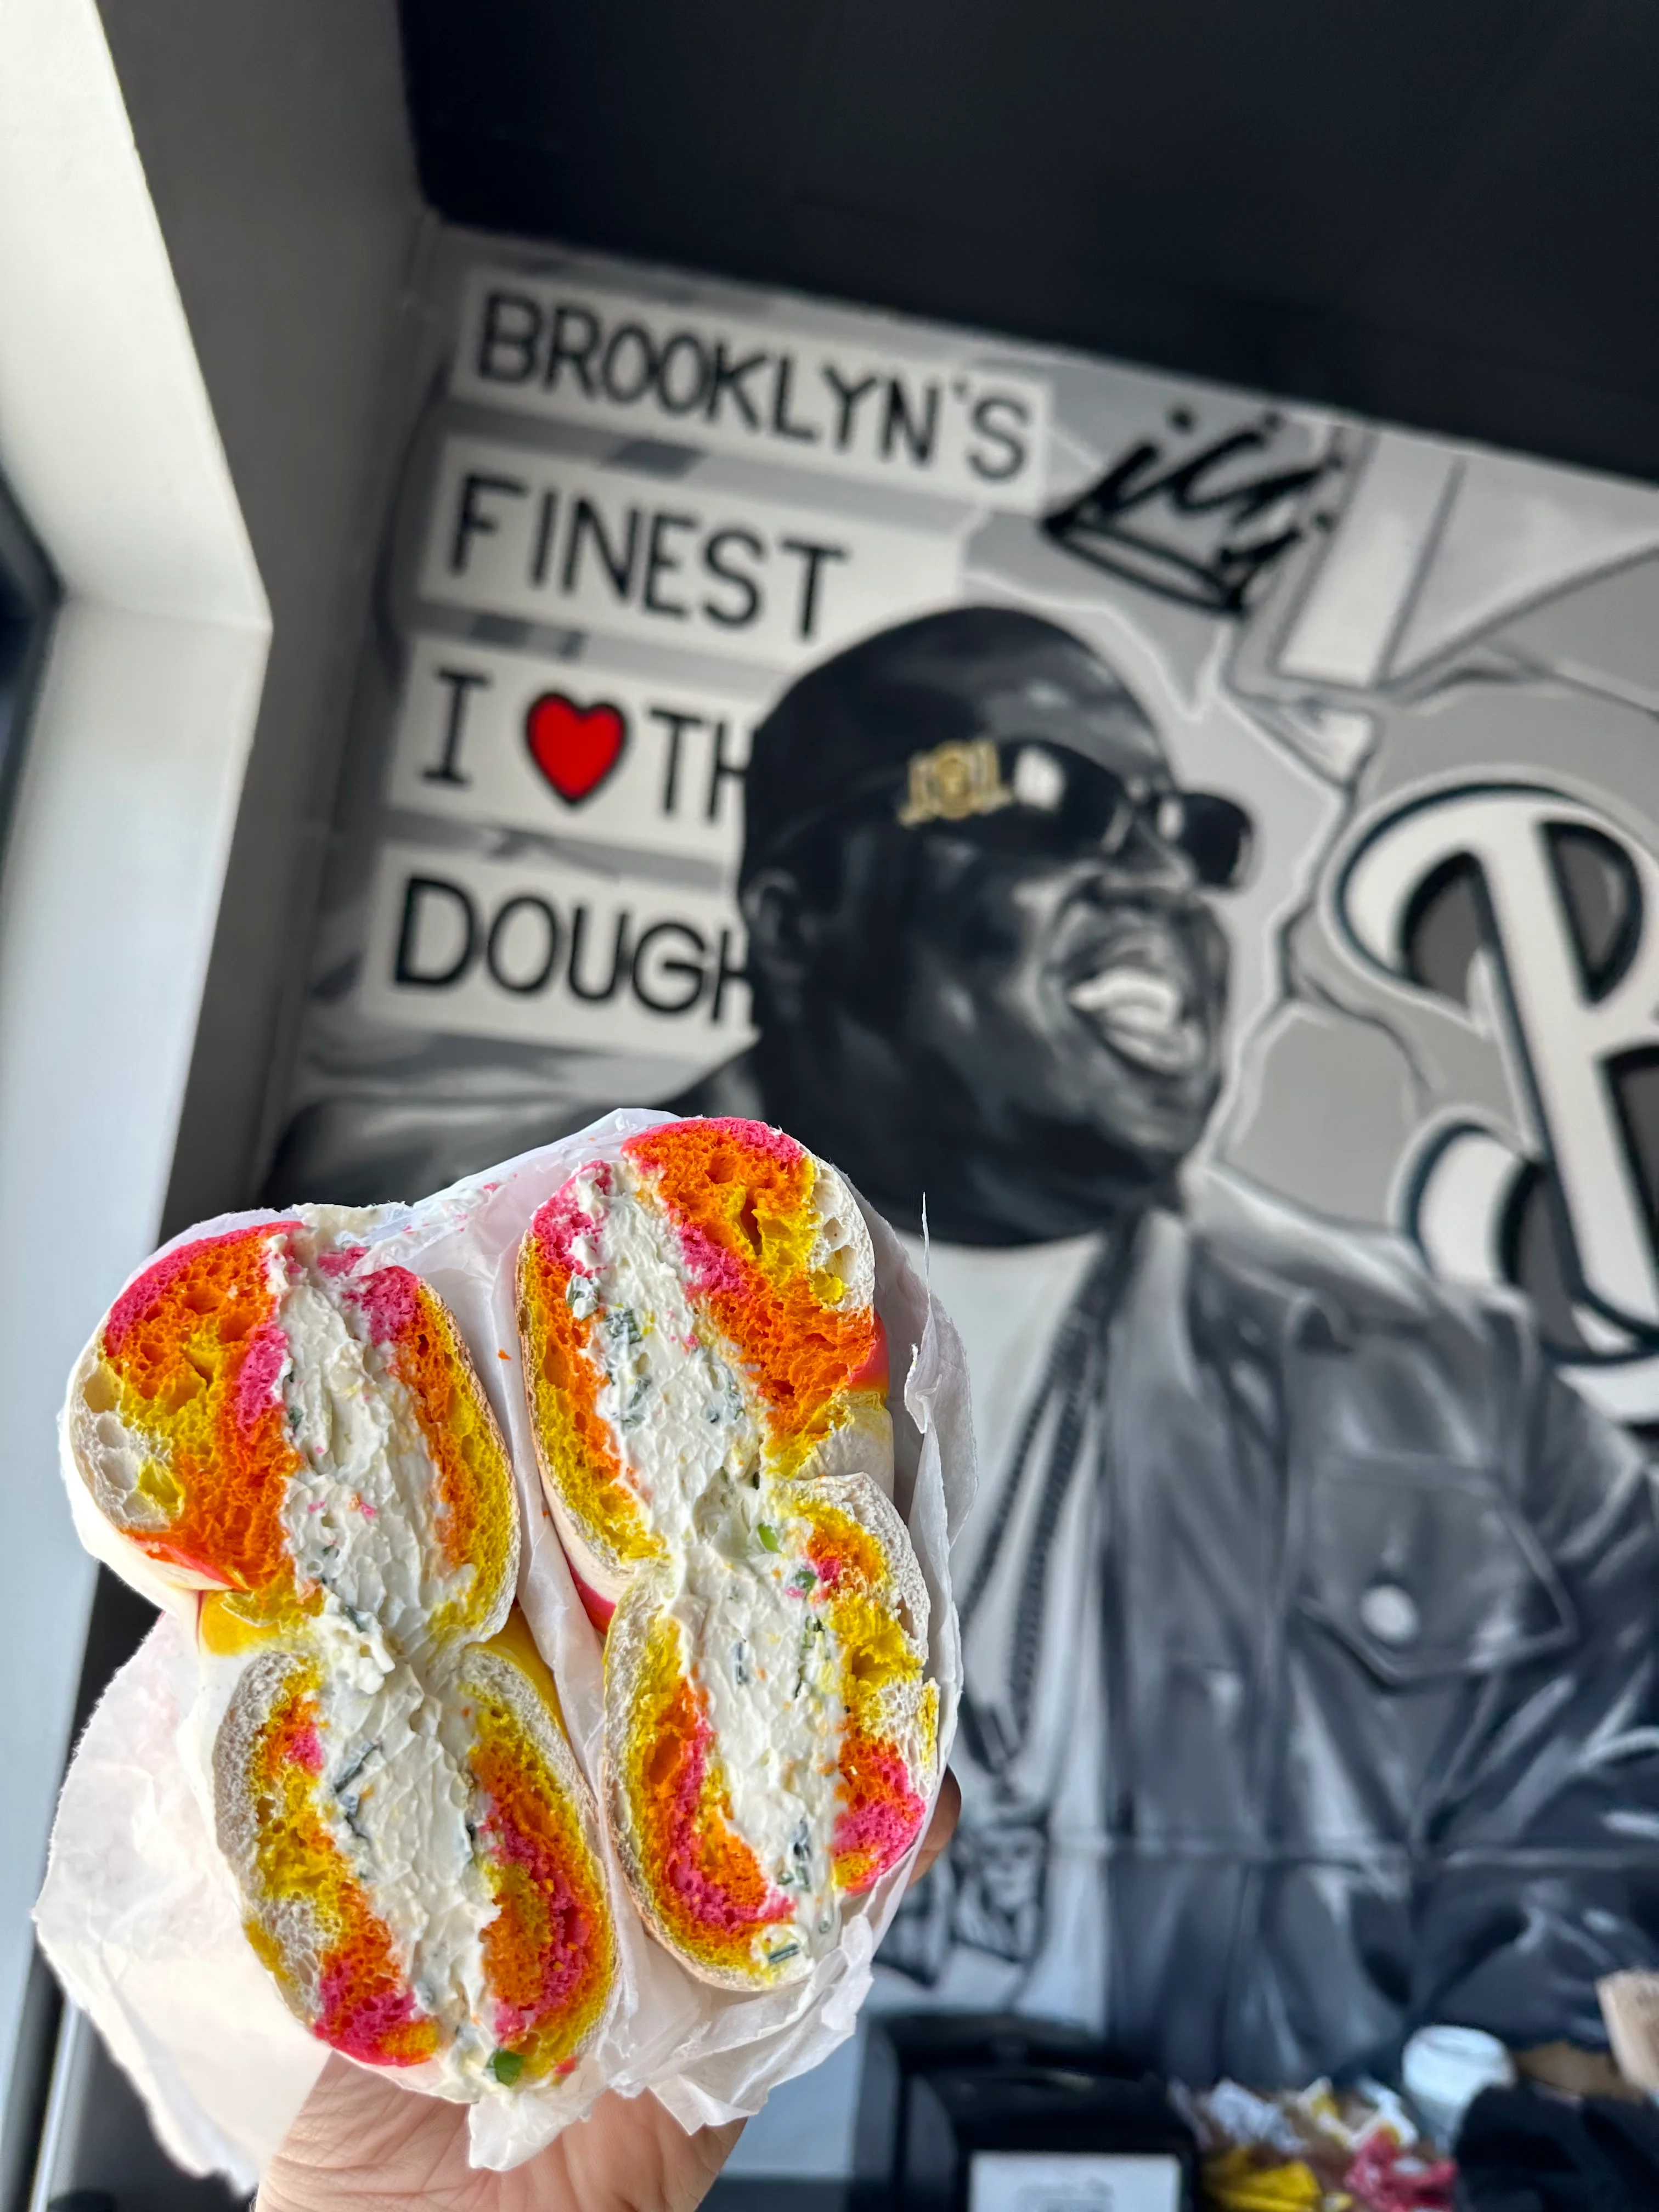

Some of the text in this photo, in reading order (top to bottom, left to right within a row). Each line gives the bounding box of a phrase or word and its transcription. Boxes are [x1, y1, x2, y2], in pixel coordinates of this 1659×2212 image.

[475, 291, 1032, 481] BROOKLYN'S
[449, 472, 850, 641] FINEST
[421, 668, 492, 787] I
